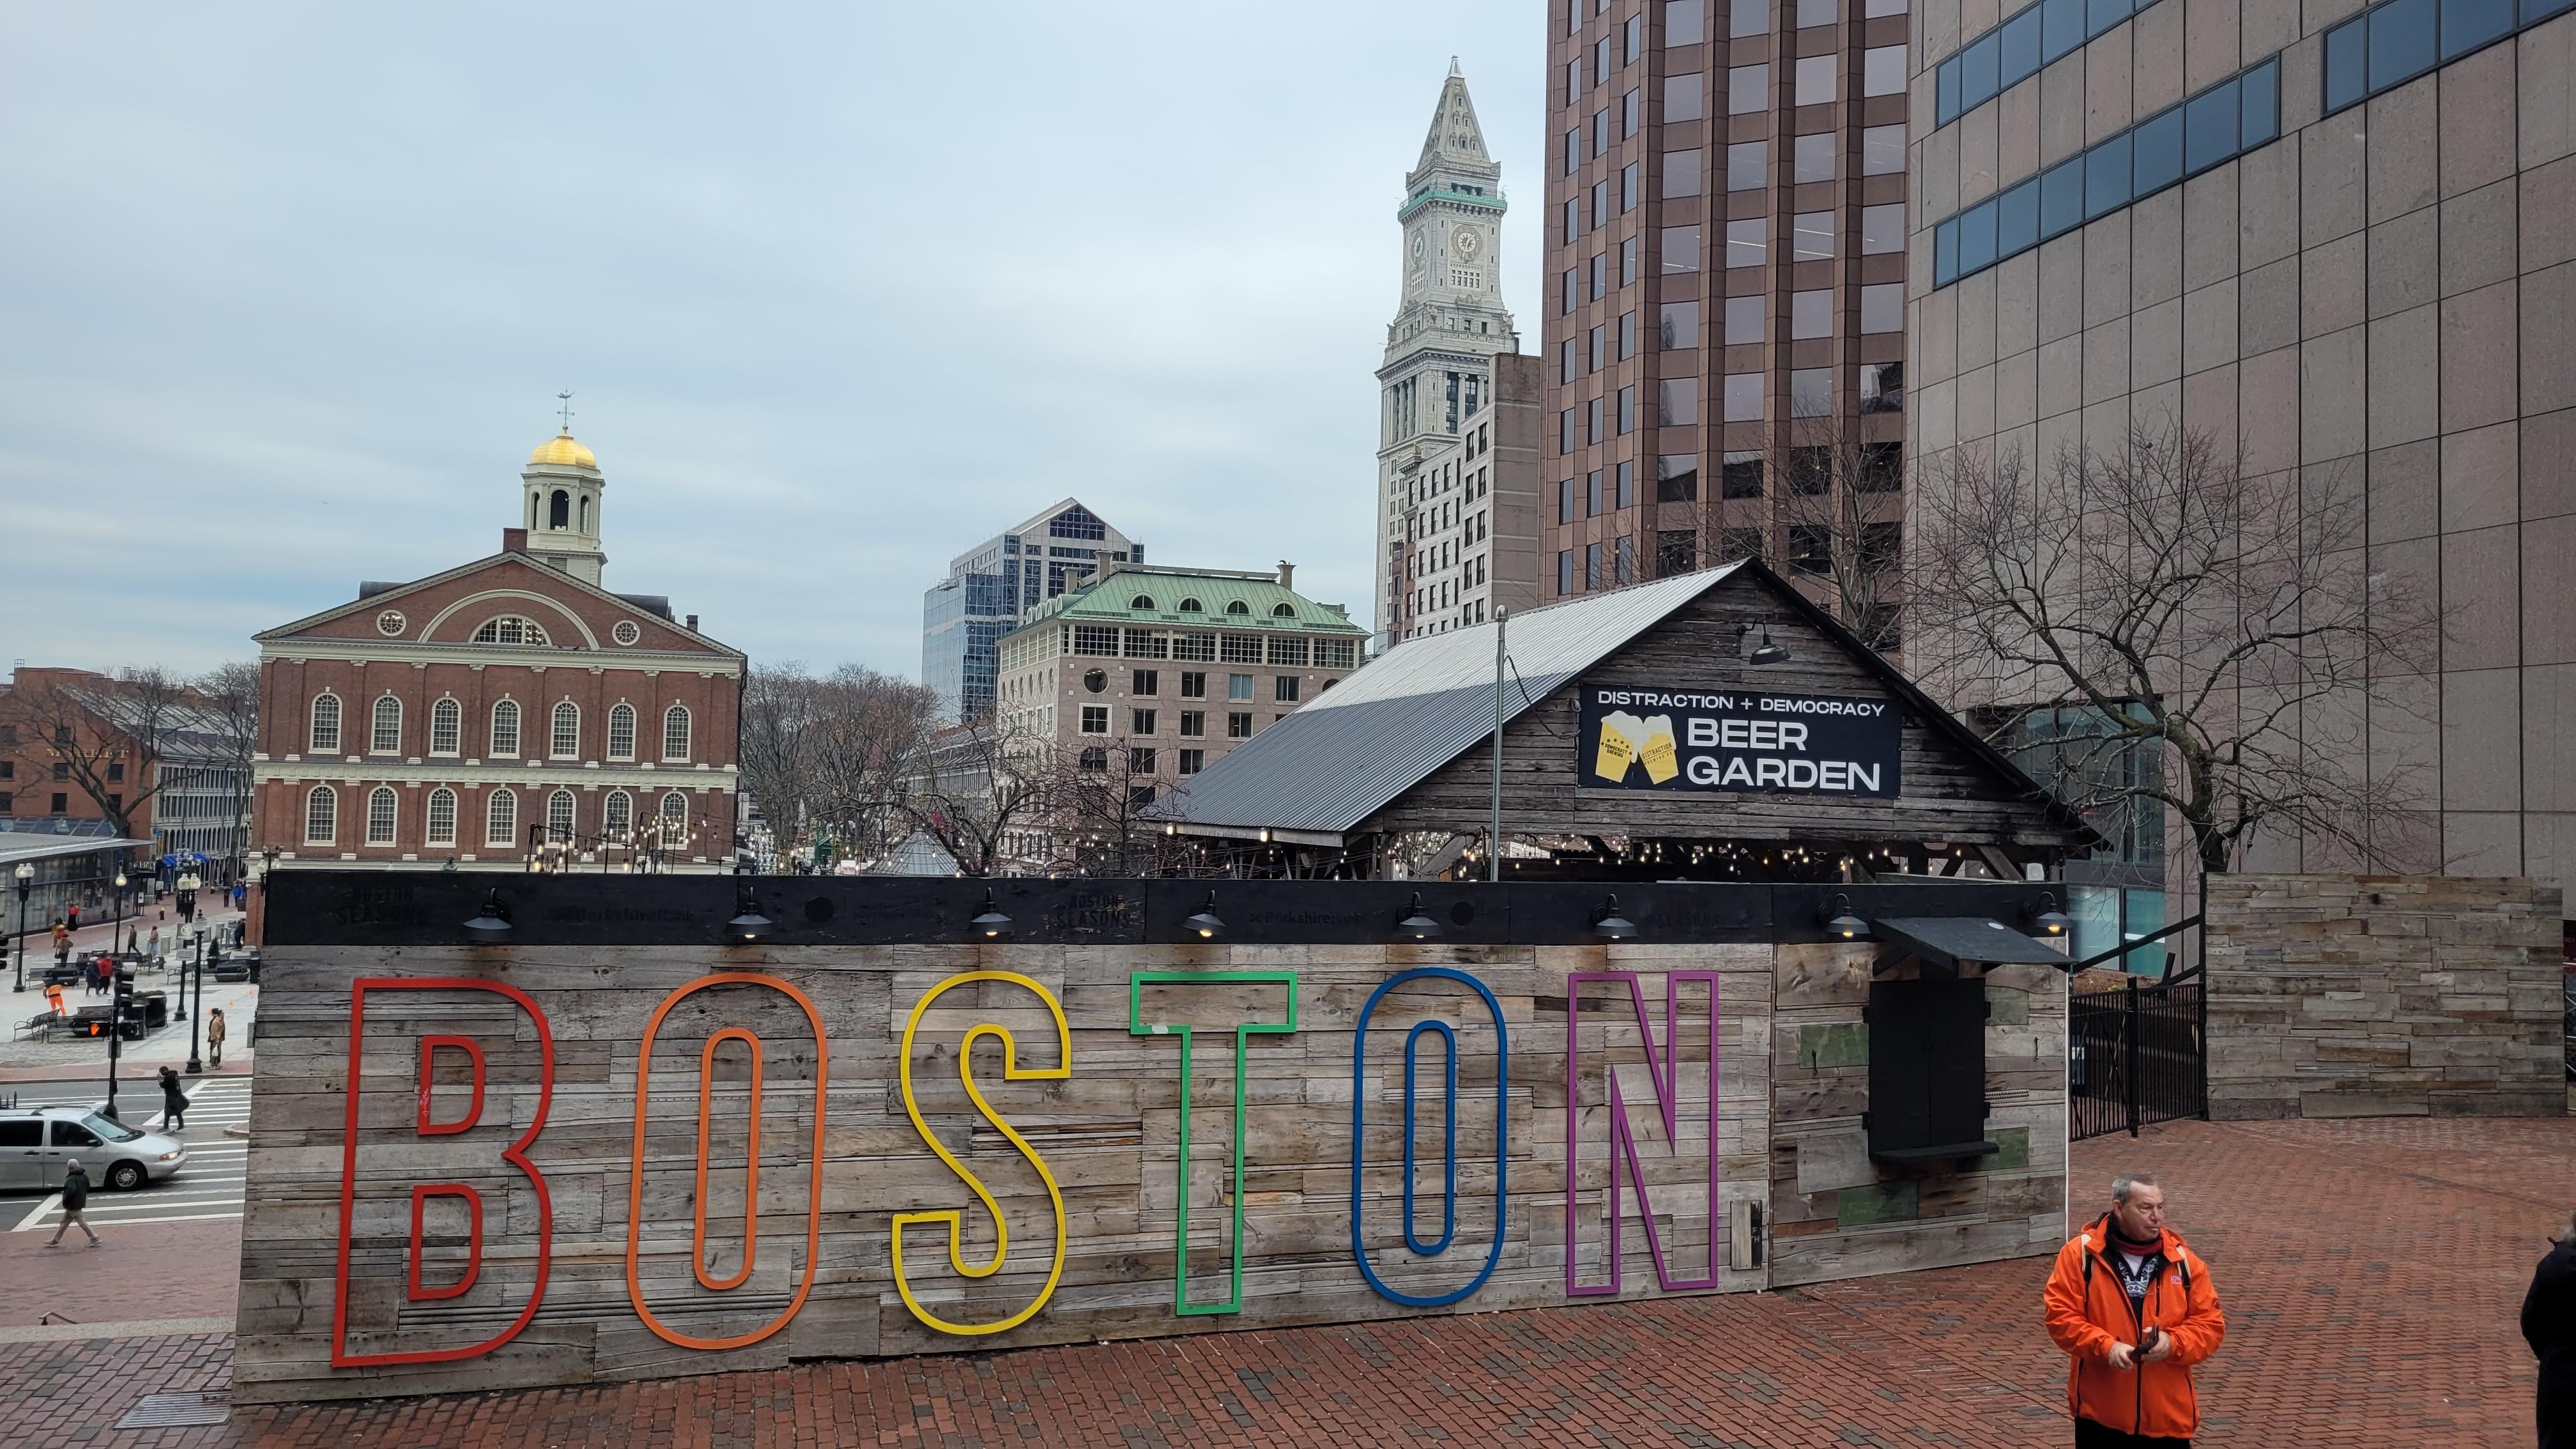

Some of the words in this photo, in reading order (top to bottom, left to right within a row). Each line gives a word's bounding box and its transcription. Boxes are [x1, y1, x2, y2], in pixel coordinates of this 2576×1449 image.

[1598, 691, 1734, 710] DISTRACTION
[1740, 698, 1754, 710] +
[1760, 698, 1885, 717] DEMOCRACY
[1687, 717, 1809, 751] BEER
[1604, 743, 1628, 755] DEMOCRACY
[1606, 748, 1623, 758] BREWING
[1641, 742, 1672, 759] DISTRACTION
[1687, 756, 1880, 792] GARDEN
[332, 968, 1719, 1367] BOSTON
